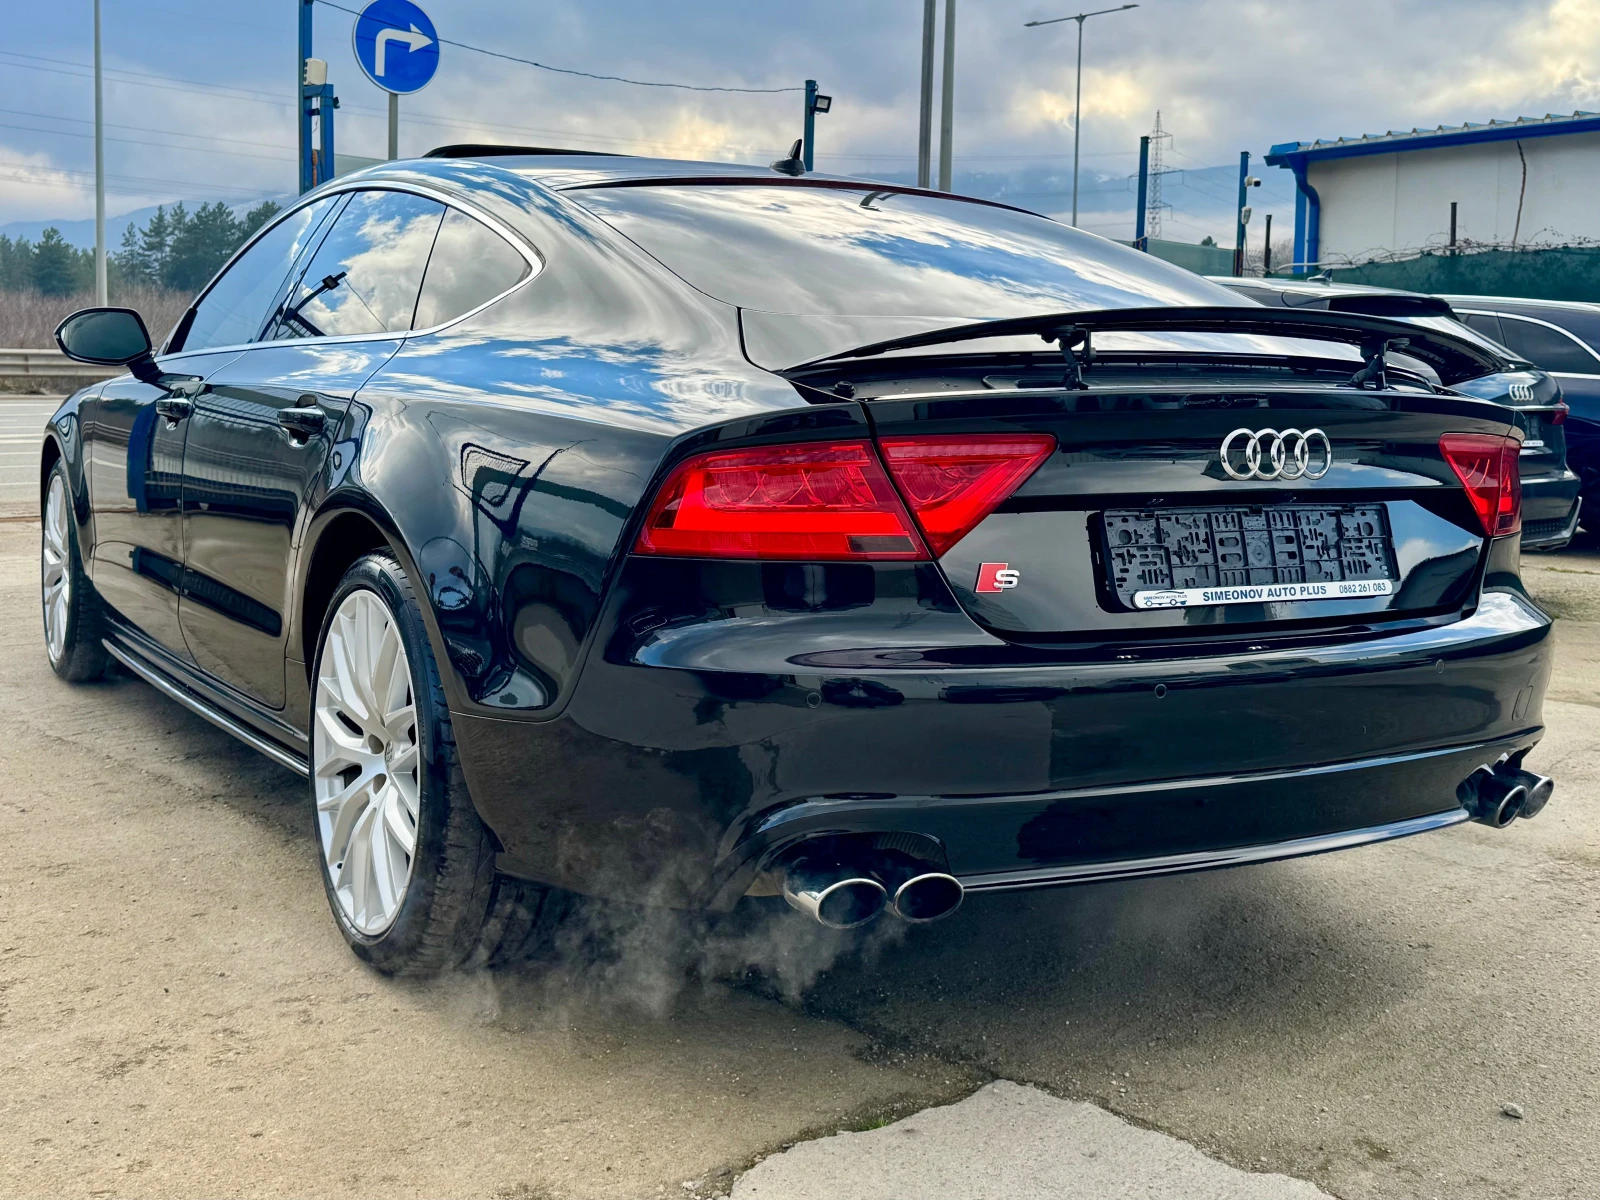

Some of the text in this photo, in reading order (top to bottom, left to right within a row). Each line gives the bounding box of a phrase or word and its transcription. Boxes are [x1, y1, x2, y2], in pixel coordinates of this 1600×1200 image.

[993, 569, 1020, 589] S
[1203, 585, 1327, 602] SIMEONOV AUTO PLUS
[1339, 582, 1386, 594] 0882 261 083
